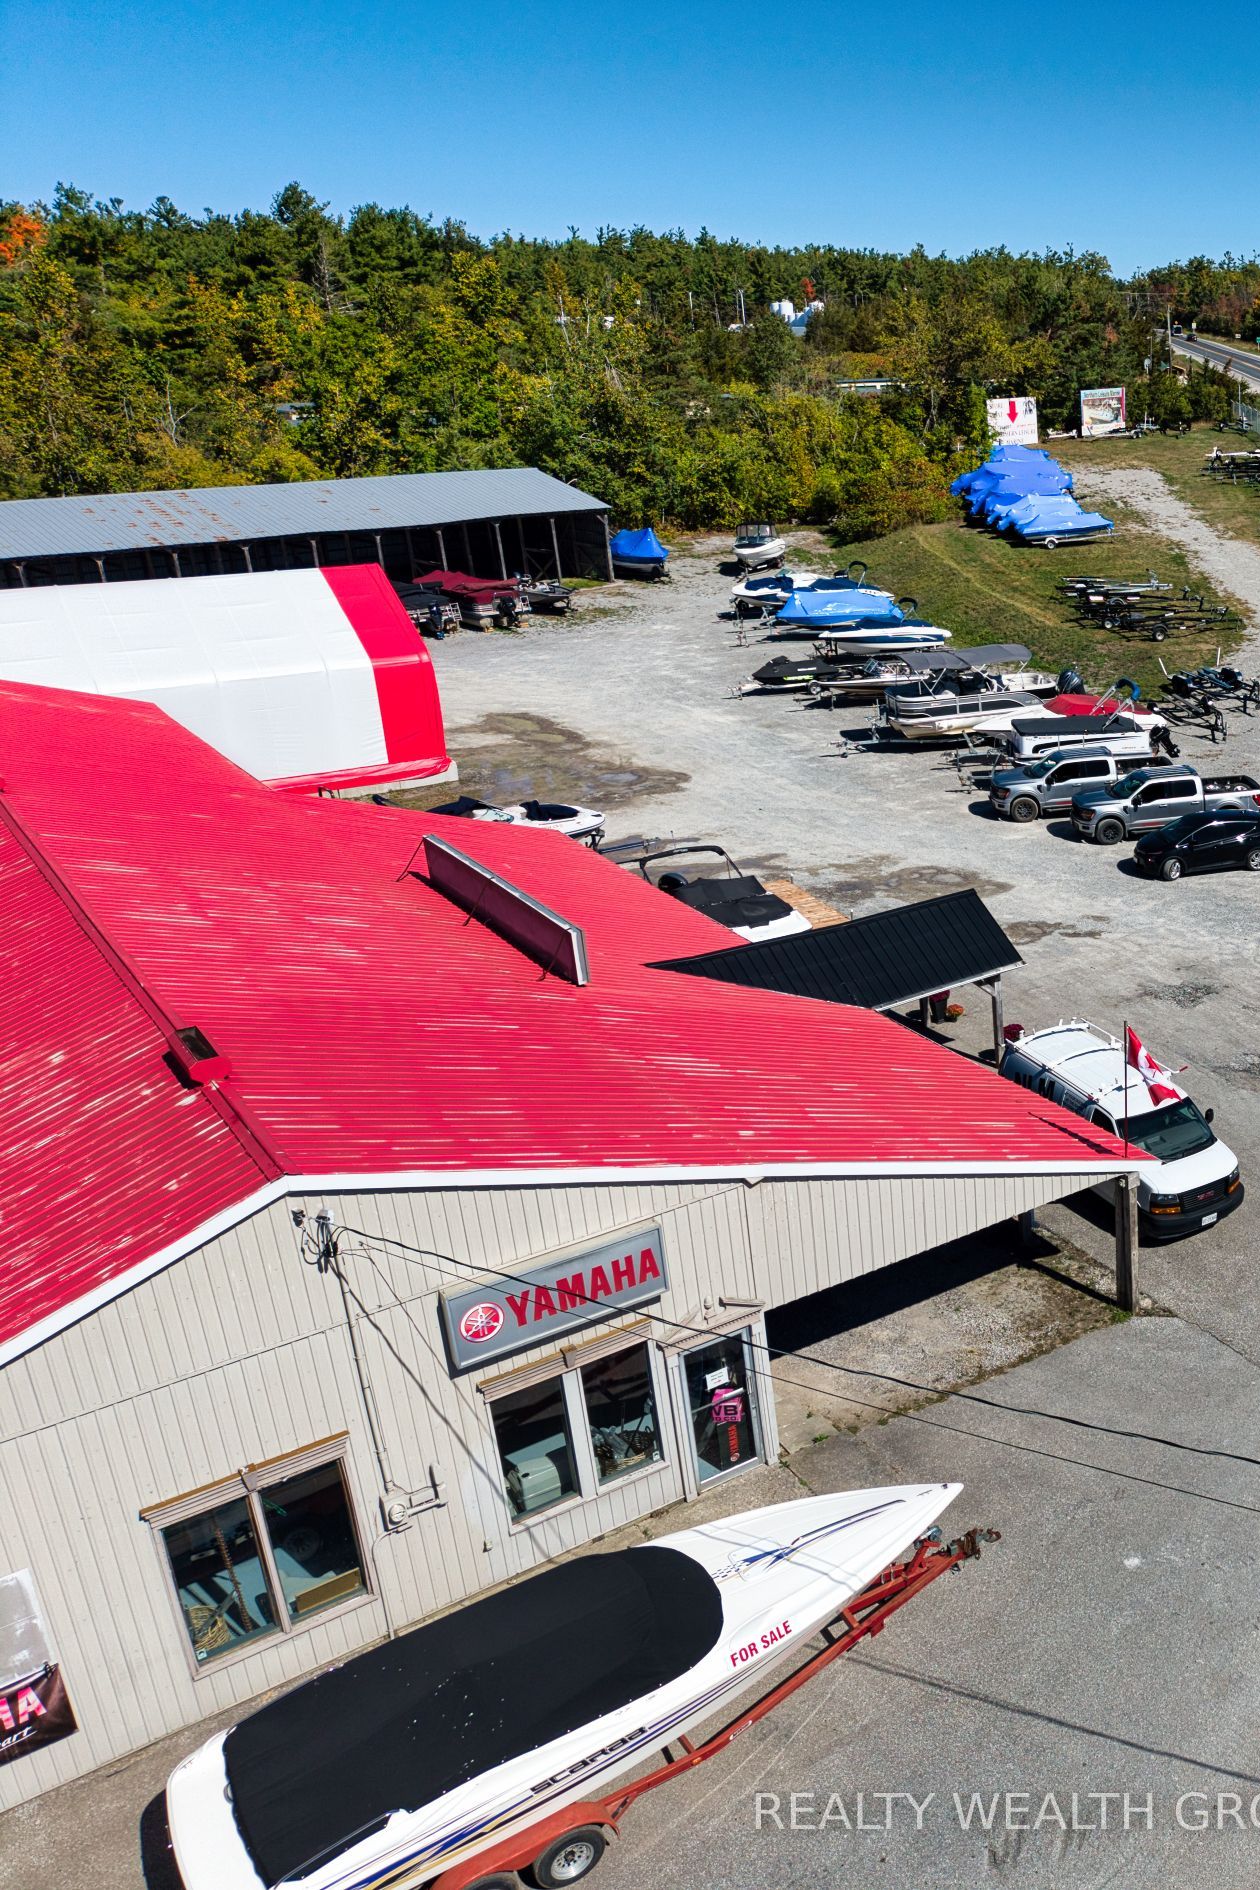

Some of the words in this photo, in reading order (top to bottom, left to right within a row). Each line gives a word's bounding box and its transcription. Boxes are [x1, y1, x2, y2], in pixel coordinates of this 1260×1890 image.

[505, 1248, 660, 1328] YAMAHA
[730, 1642, 759, 1668] FOR
[760, 1620, 792, 1649] SALE
